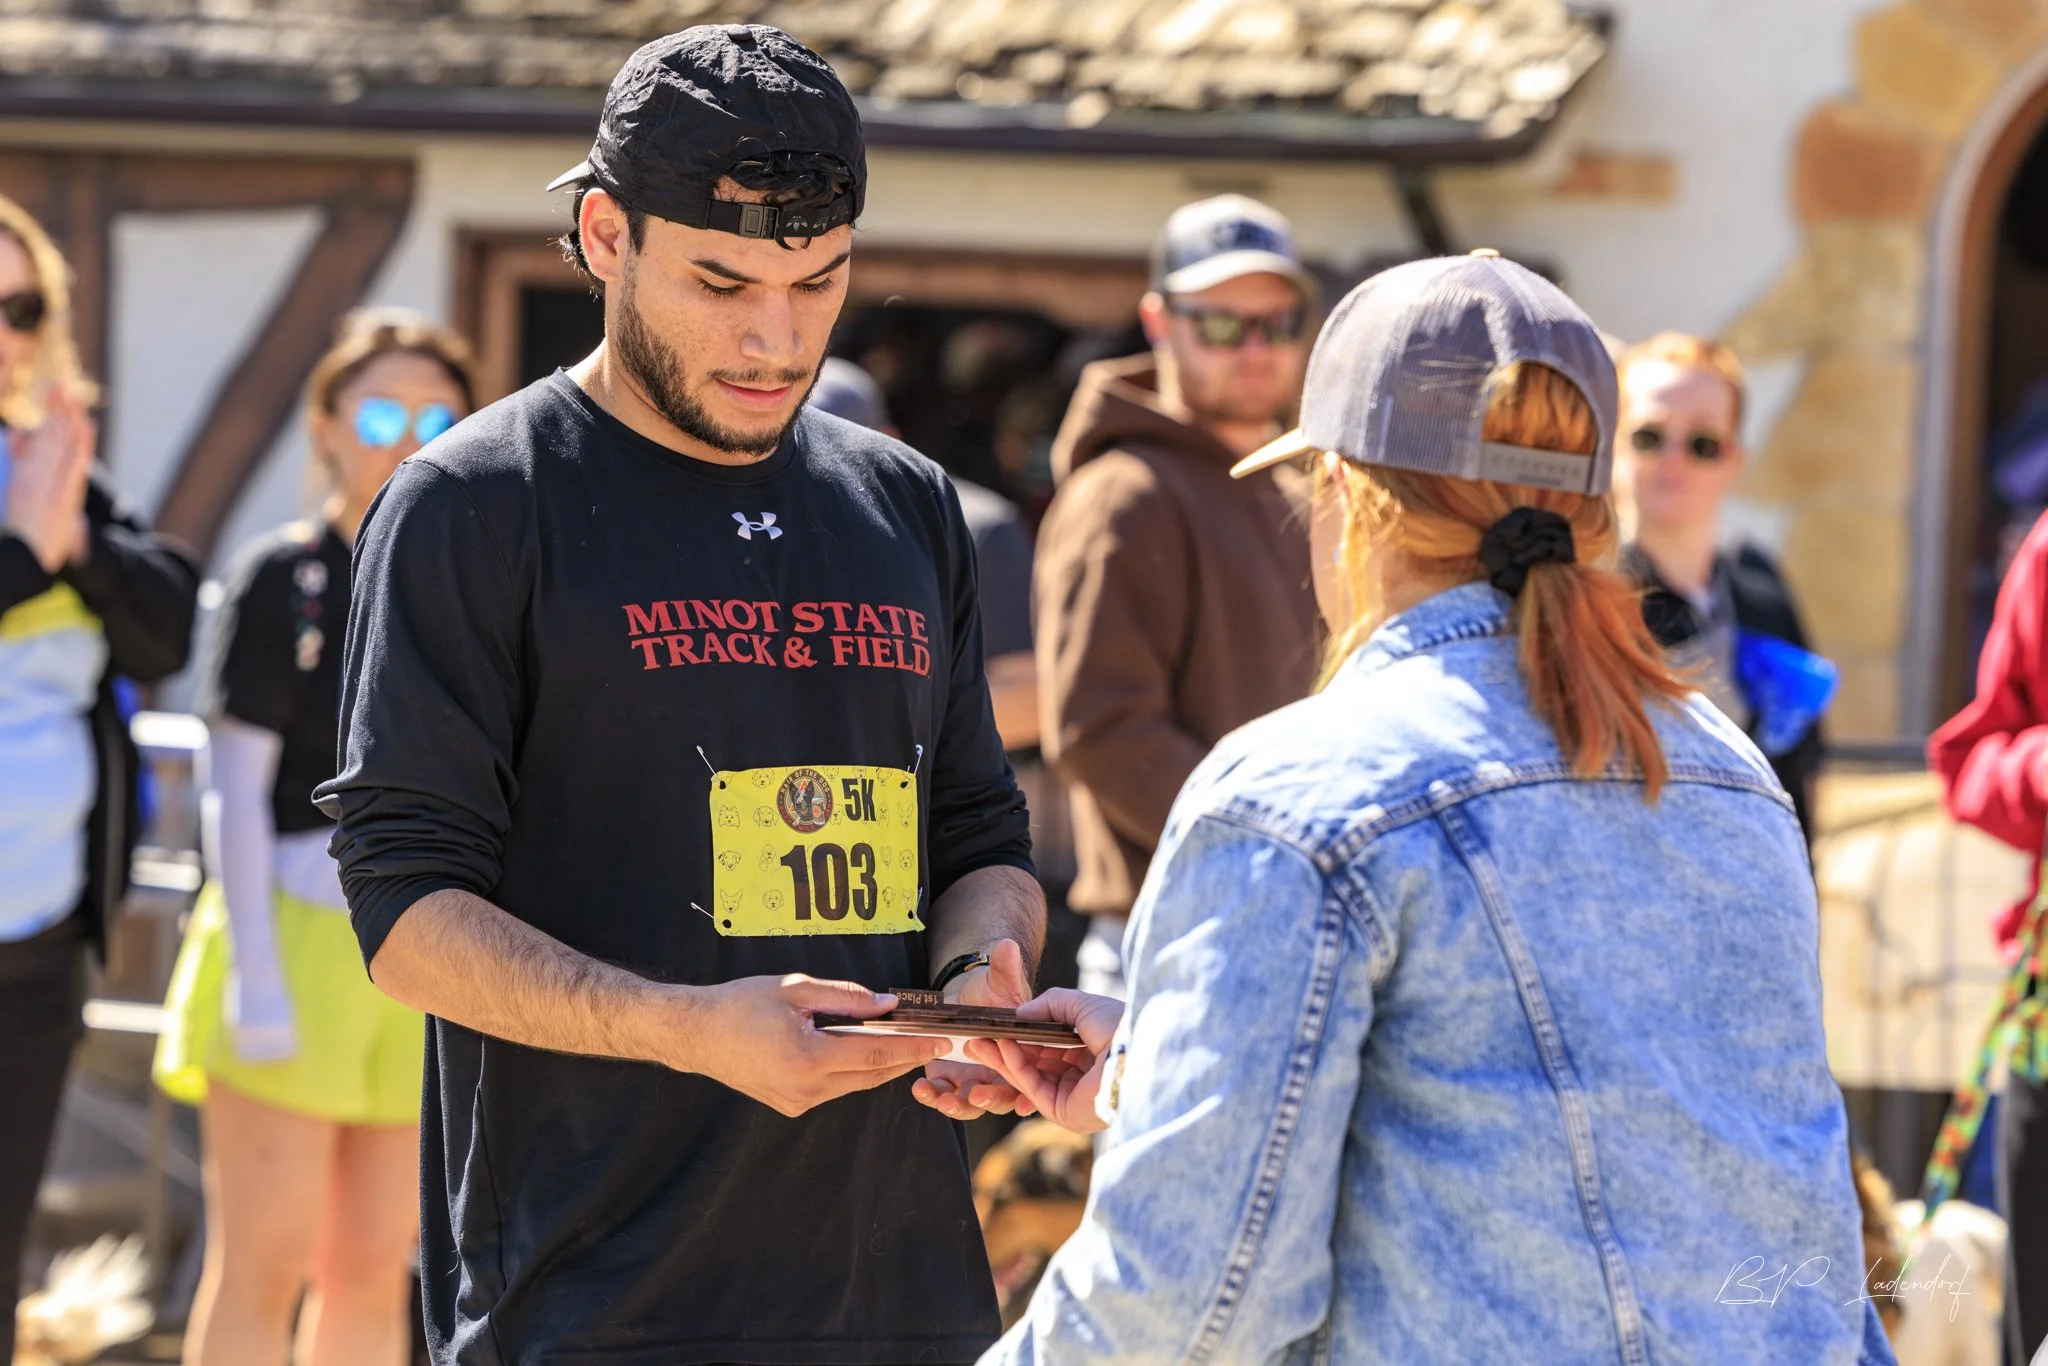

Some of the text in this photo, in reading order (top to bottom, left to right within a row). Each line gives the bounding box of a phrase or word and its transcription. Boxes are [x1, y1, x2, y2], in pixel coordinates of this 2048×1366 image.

[622, 599, 929, 643] MINOT STATE
[631, 631, 931, 677] TRACK & FIELD
[780, 776, 794, 794] HAIR
[794, 770, 803, 778] OF
[805, 769, 817, 779] THE
[841, 778, 876, 822] 5K
[780, 842, 878, 921] 103
[896, 991, 938, 1006] 1st Place
